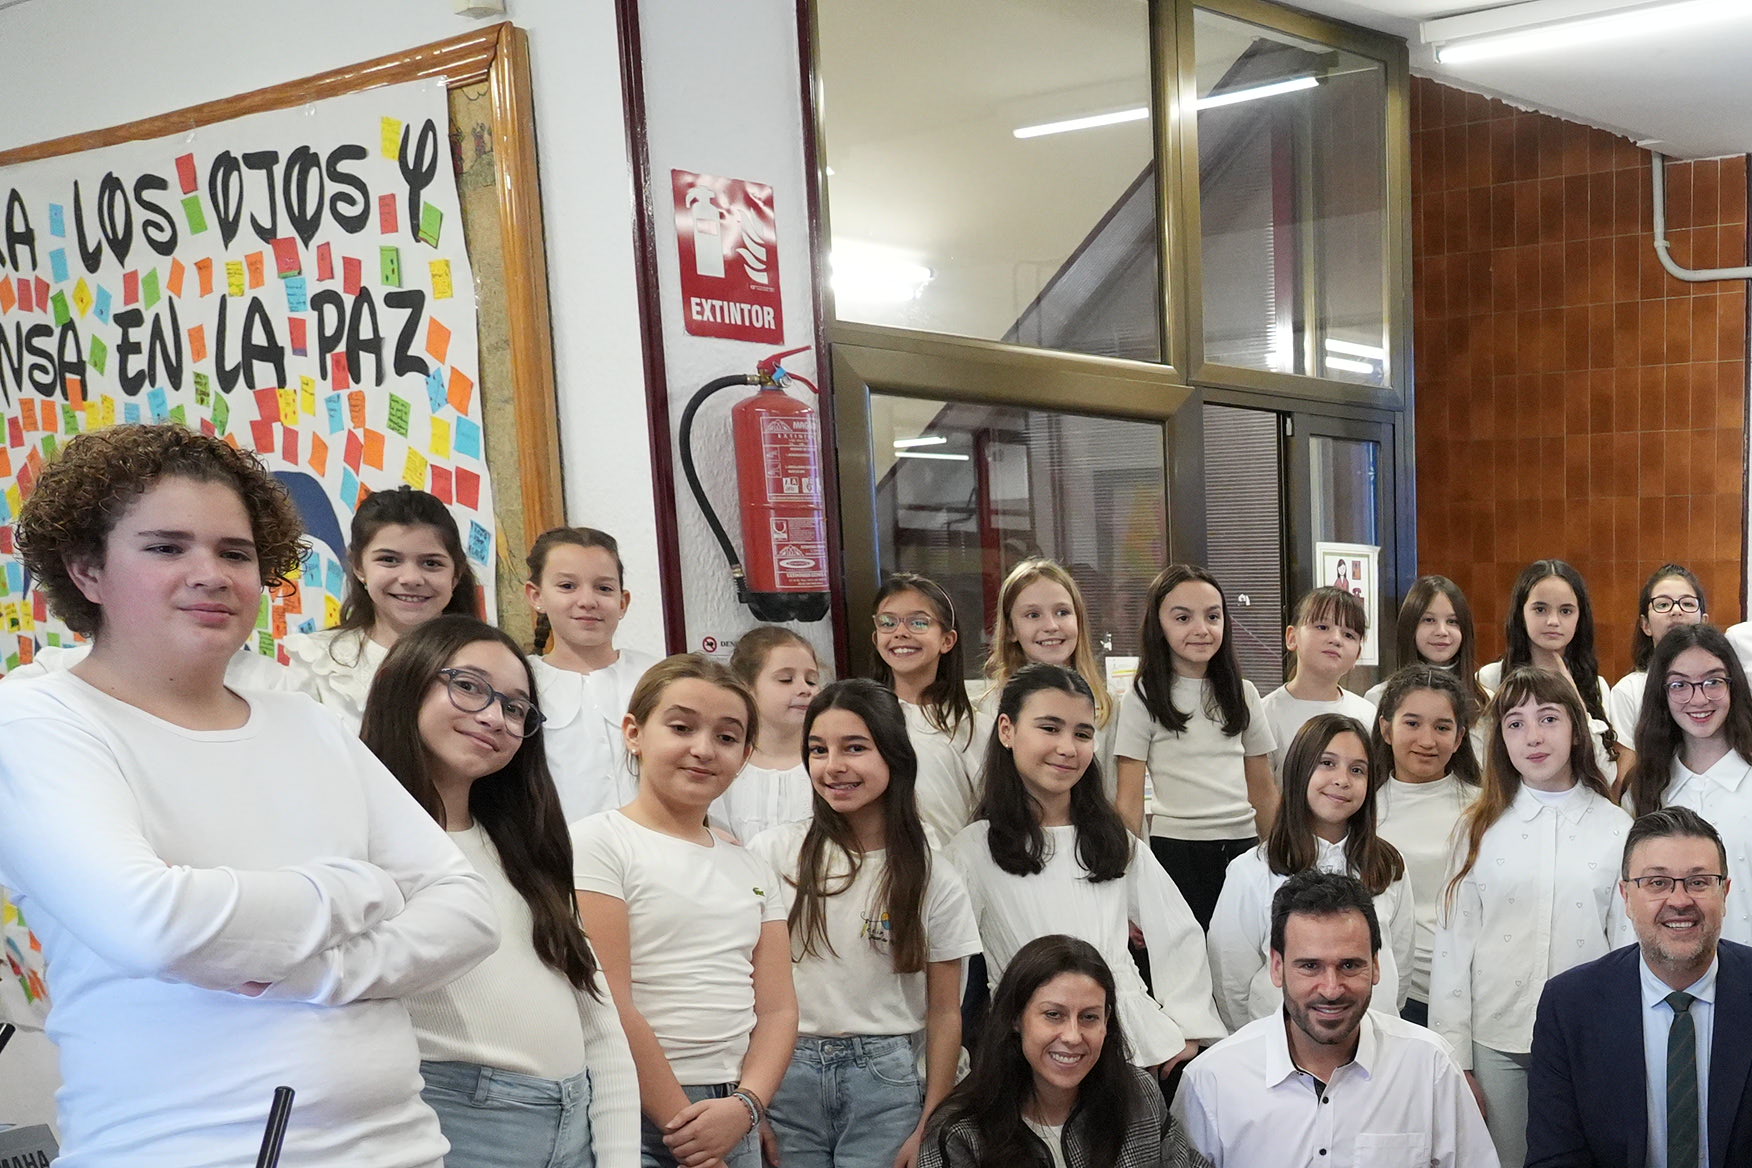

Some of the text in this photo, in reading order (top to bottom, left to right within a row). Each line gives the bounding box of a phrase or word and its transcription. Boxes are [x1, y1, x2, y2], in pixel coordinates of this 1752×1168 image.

[73, 171, 178, 274] LOS
[208, 144, 371, 251] OJOS
[398, 118, 439, 244] Y
[113, 295, 184, 396] EN
[215, 294, 288, 394] LA
[310, 286, 430, 387] PAZ
[690, 297, 777, 330] EXTINTOR
